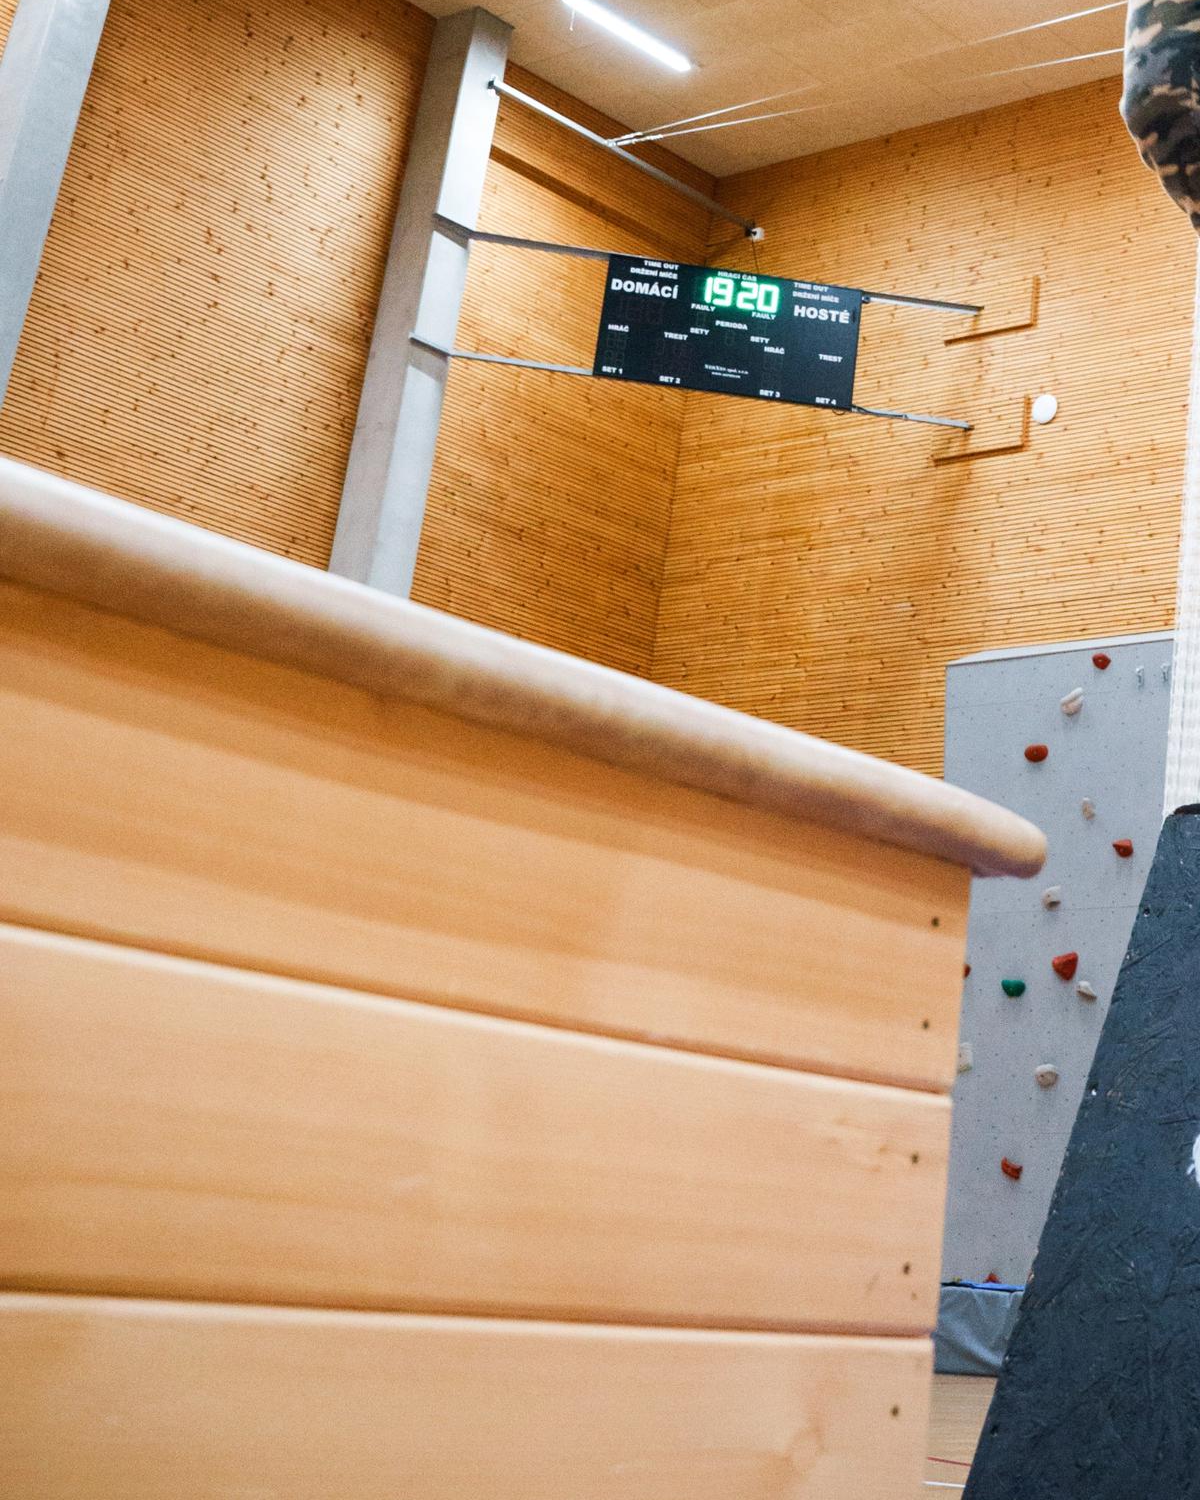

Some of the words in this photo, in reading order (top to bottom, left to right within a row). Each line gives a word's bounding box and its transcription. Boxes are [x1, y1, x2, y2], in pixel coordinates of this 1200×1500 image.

[644, 260, 662, 268] TIME
[663, 262, 679, 270] OUT
[611, 278, 679, 299] DOMÁCÍ
[812, 284, 829, 292] OUT
[691, 303, 716, 312] FAULY
[751, 311, 776, 320] FAULY
[794, 304, 850, 324] HOSTÉ
[664, 331, 688, 340] TREST
[690, 327, 710, 335] SETY
[750, 335, 770, 344] SETY
[818, 353, 843, 363] TREST
[602, 365, 617, 374] SET
[659, 375, 674, 383] SET
[759, 389, 775, 397] SET
[815, 396, 831, 404] SET
